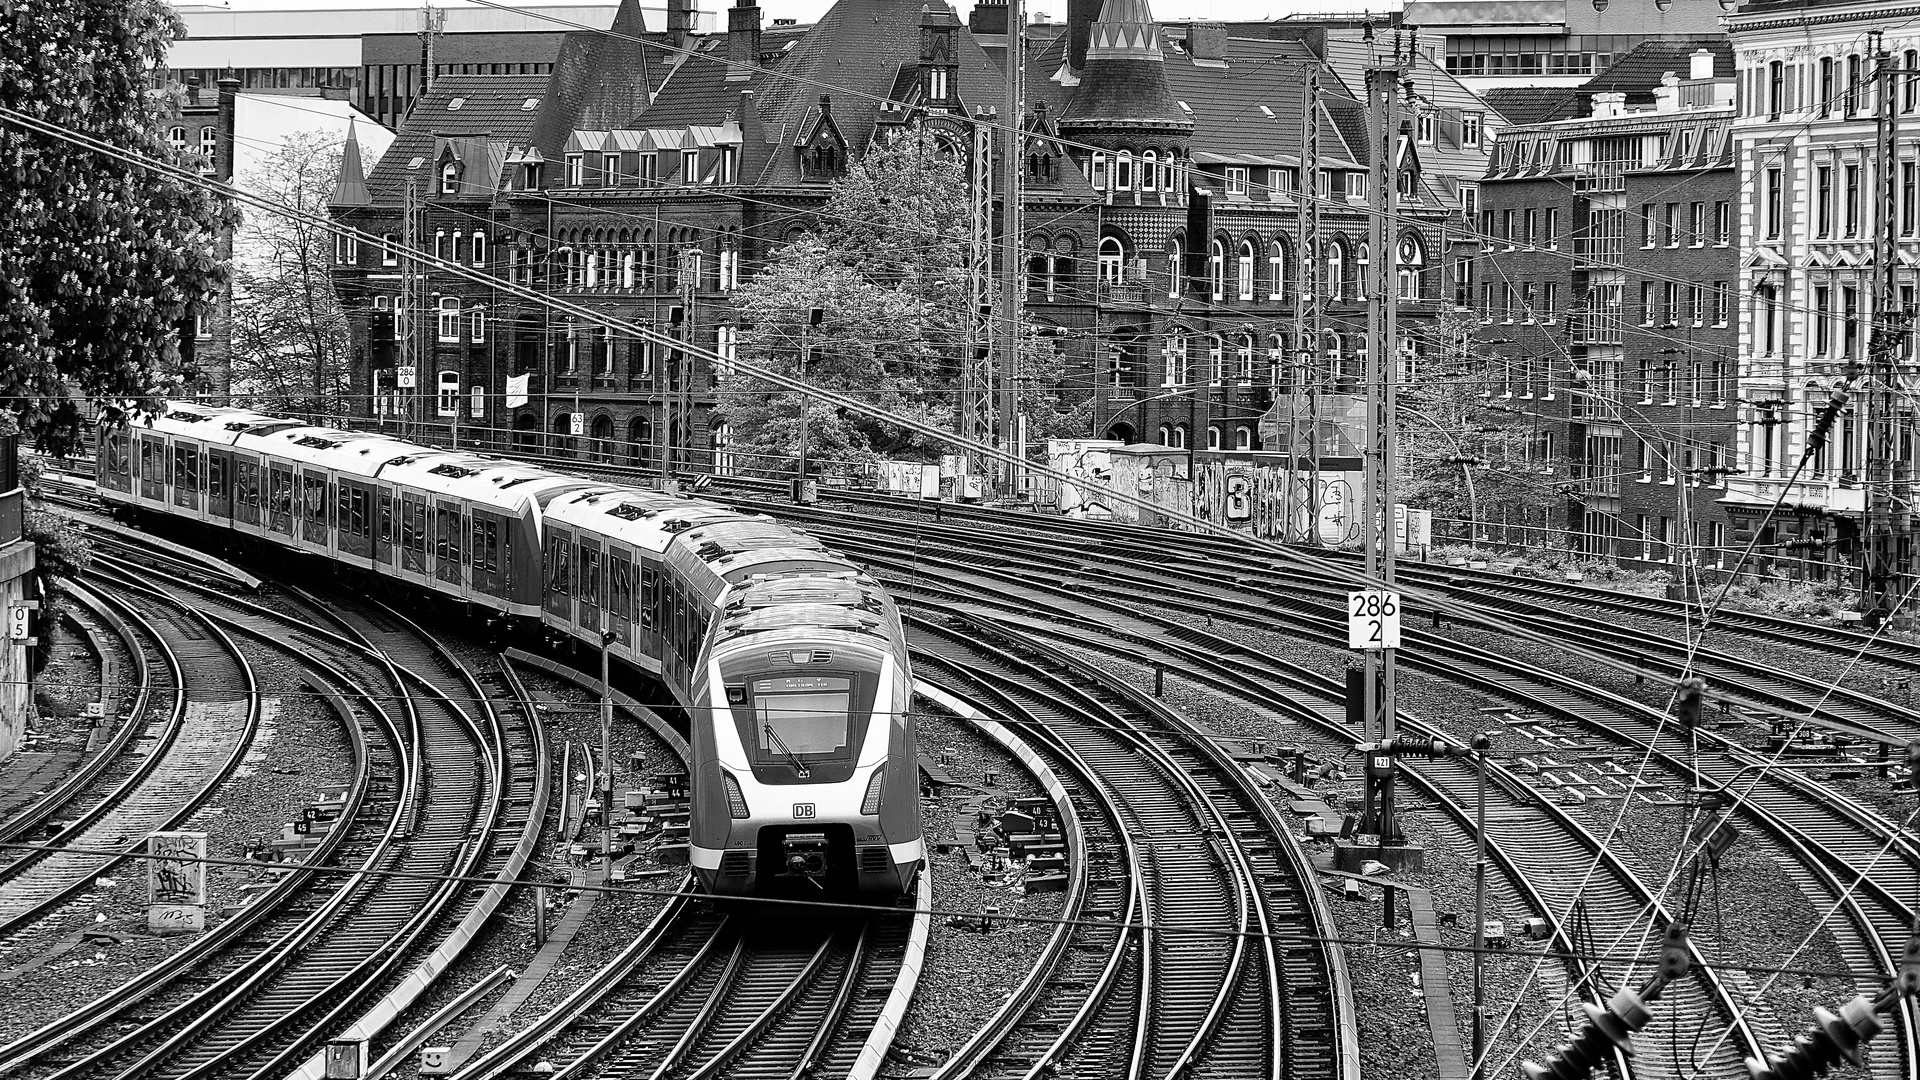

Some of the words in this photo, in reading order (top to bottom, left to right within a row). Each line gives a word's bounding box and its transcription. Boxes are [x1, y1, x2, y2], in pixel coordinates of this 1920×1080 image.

[399, 367, 414, 376] 286
[403, 377, 410, 385] 0
[572, 414, 583, 423] 63
[574, 424, 580, 432] 2
[1353, 594, 1396, 617] 286
[15, 608, 25, 621] 0
[15, 624, 23, 636] 5
[1368, 620, 1382, 642] 2
[1376, 758, 1388, 767] 421
[669, 776, 677, 785] 41
[672, 789, 680, 797] 44
[307, 811, 316, 819] 42
[796, 805, 813, 817] DB
[1032, 807, 1041, 815] 40
[298, 824, 307, 832] 45
[1039, 819, 1048, 828] 43
